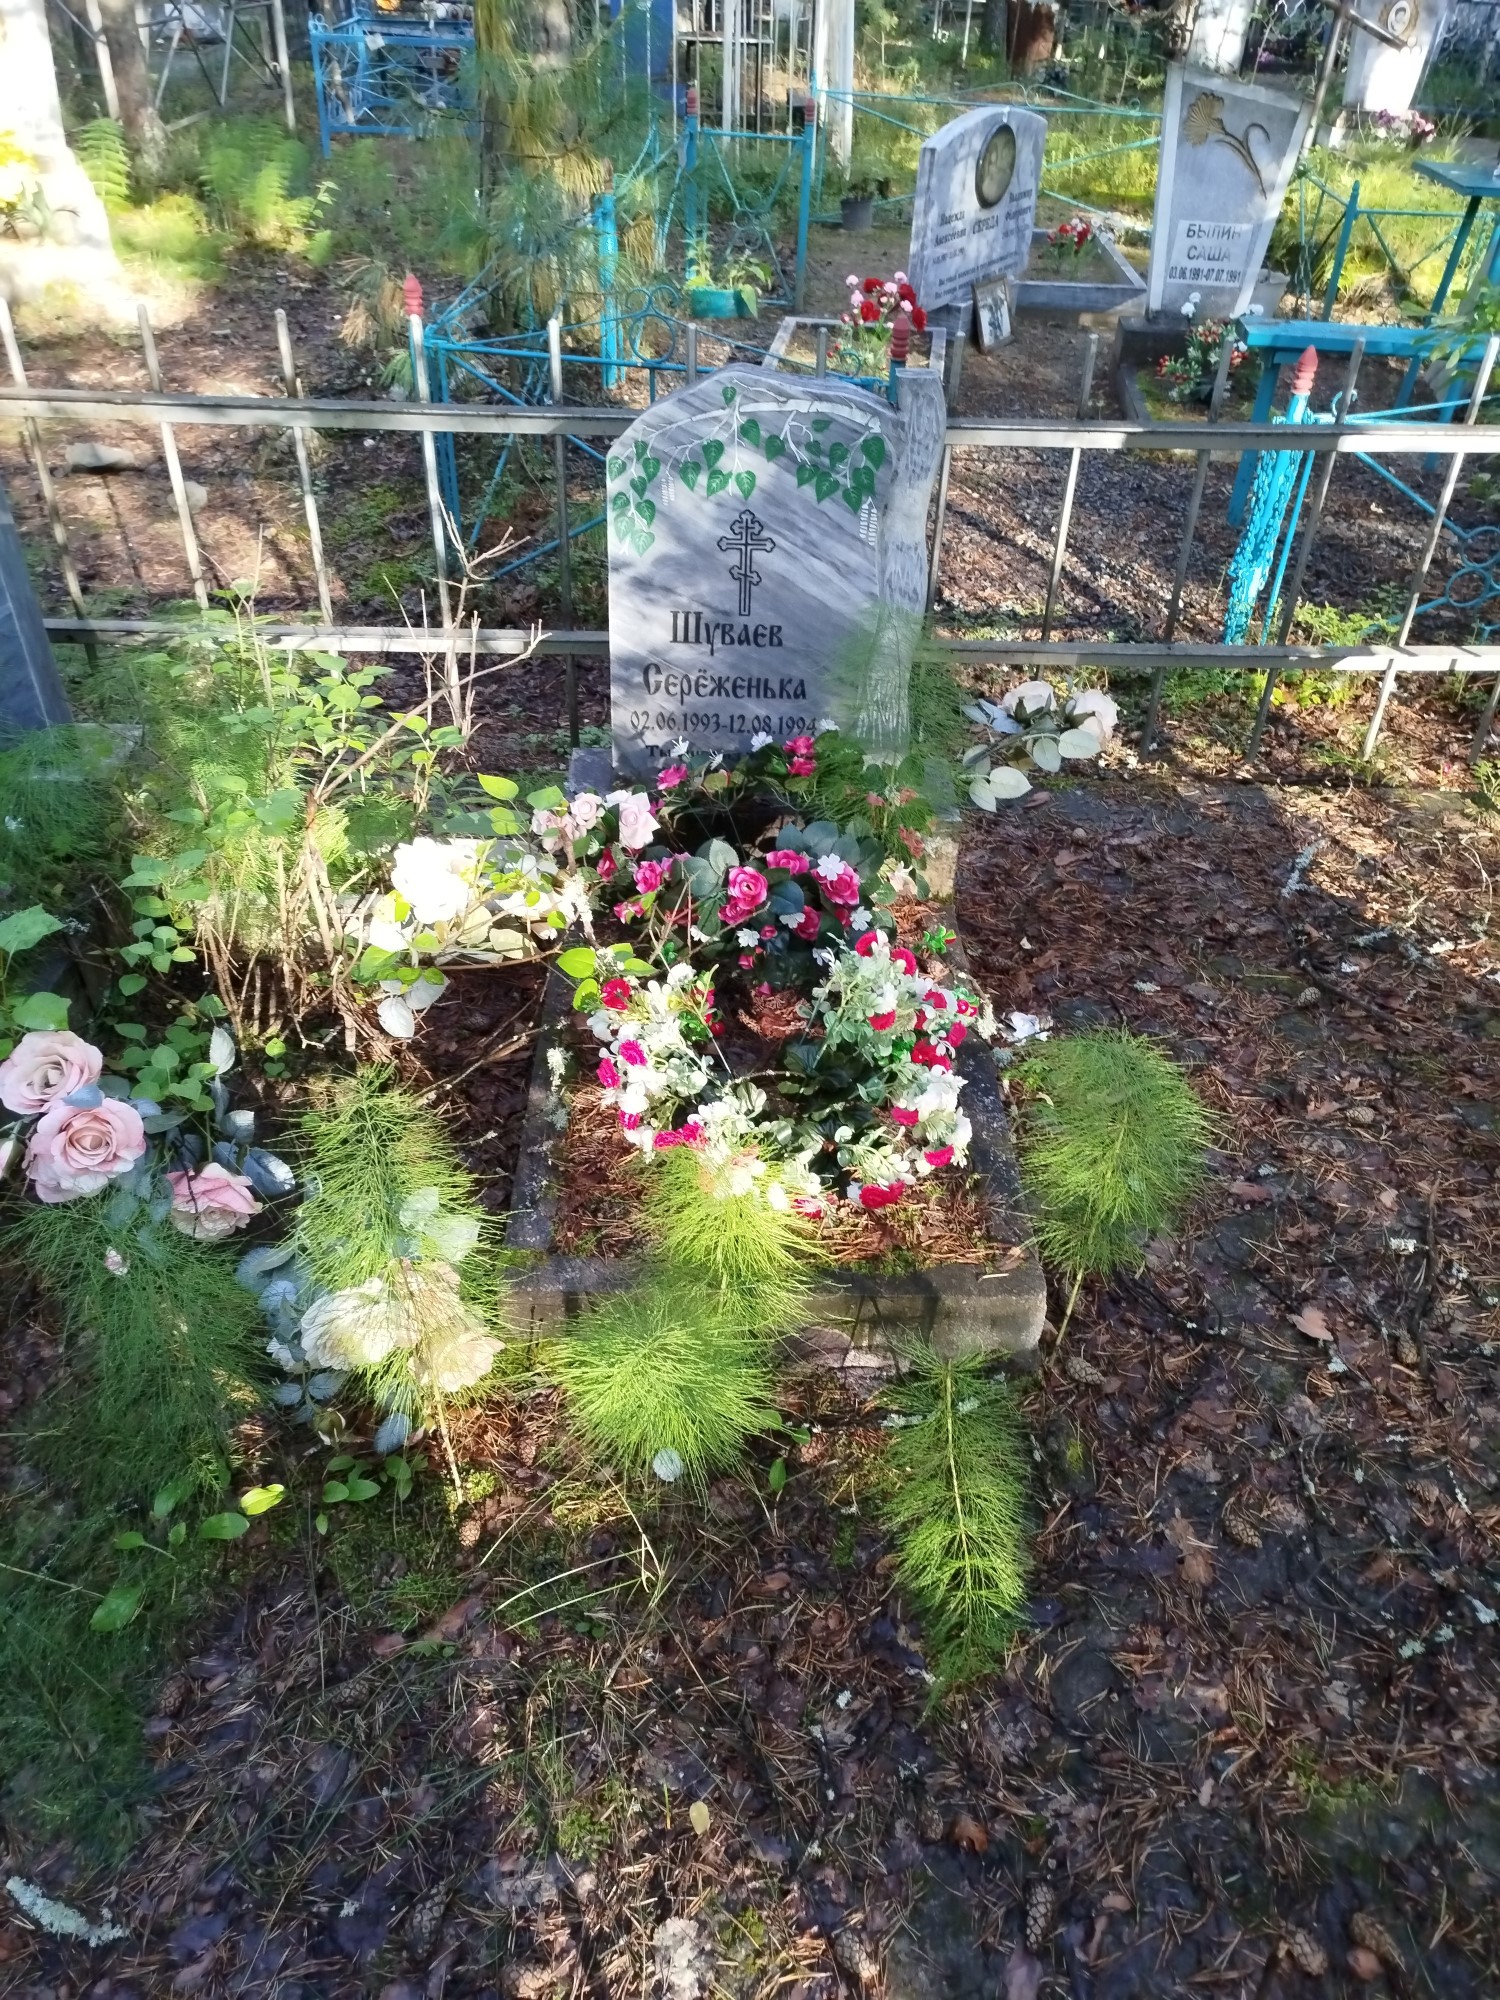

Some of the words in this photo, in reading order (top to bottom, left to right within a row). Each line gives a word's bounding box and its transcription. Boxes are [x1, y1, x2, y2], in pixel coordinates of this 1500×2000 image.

[1187, 245, 1232, 262] САША
[669, 610, 784, 656] Шуваев
[642, 662, 808, 706] Серёженька
[630, 710, 817, 736] 02.06.1993-12.08.1994
